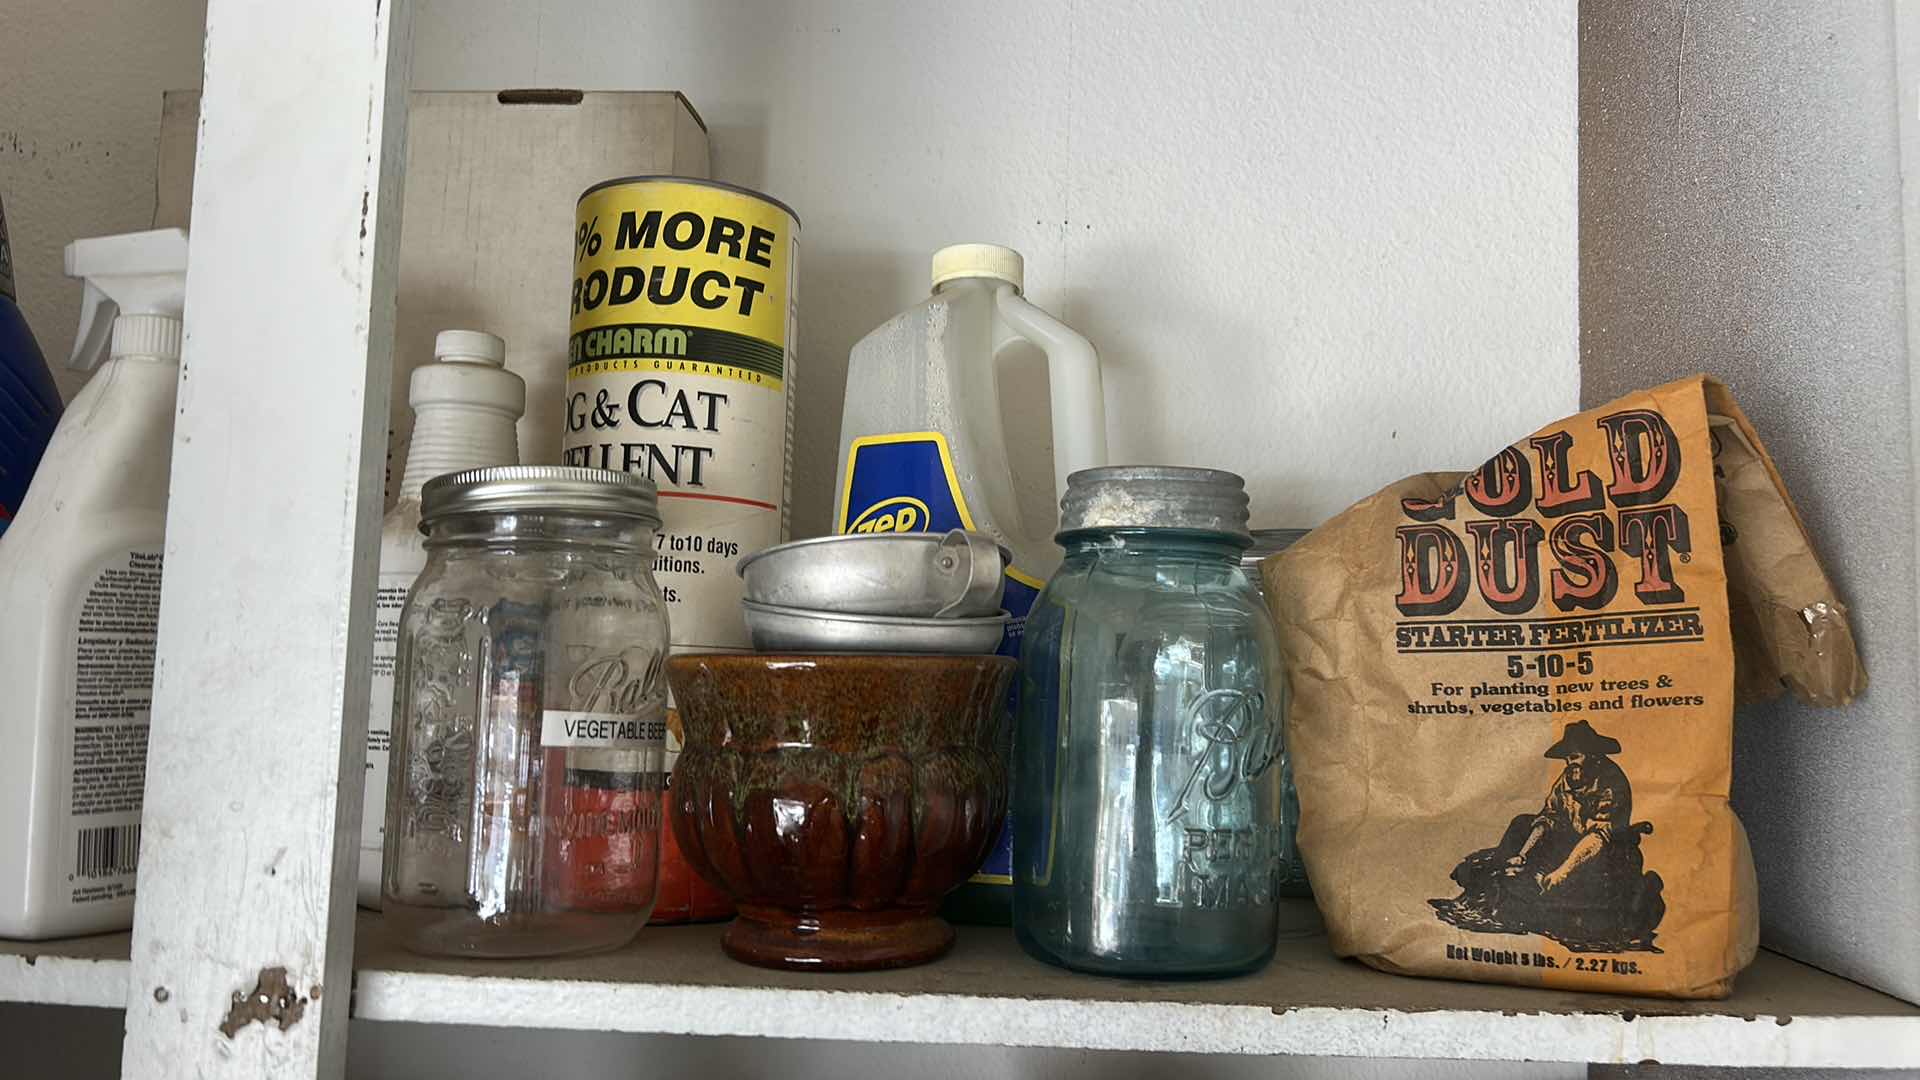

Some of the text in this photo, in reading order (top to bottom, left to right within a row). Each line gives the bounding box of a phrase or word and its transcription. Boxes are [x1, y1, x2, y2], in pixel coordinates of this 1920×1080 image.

[614, 210, 776, 269] MORE
[570, 265, 765, 317] RODUCT
[653, 361, 762, 384] GUARANTEED
[590, 388, 620, 429] &
[1401, 408, 1682, 522] OLD
[656, 534, 666, 550] 7
[707, 537, 739, 556] days
[1396, 614, 1704, 649] STARTER FERTILIZER
[1507, 651, 1595, 678] 5-10-5
[1431, 674, 1673, 699] For planting new trees &
[1407, 693, 1705, 716] shrubs, vegetables and flowers
[564, 719, 645, 740] VEGETABLE
[1446, 944, 1642, 976] Net Weight 5 lbs. / 2.27 kgs.
